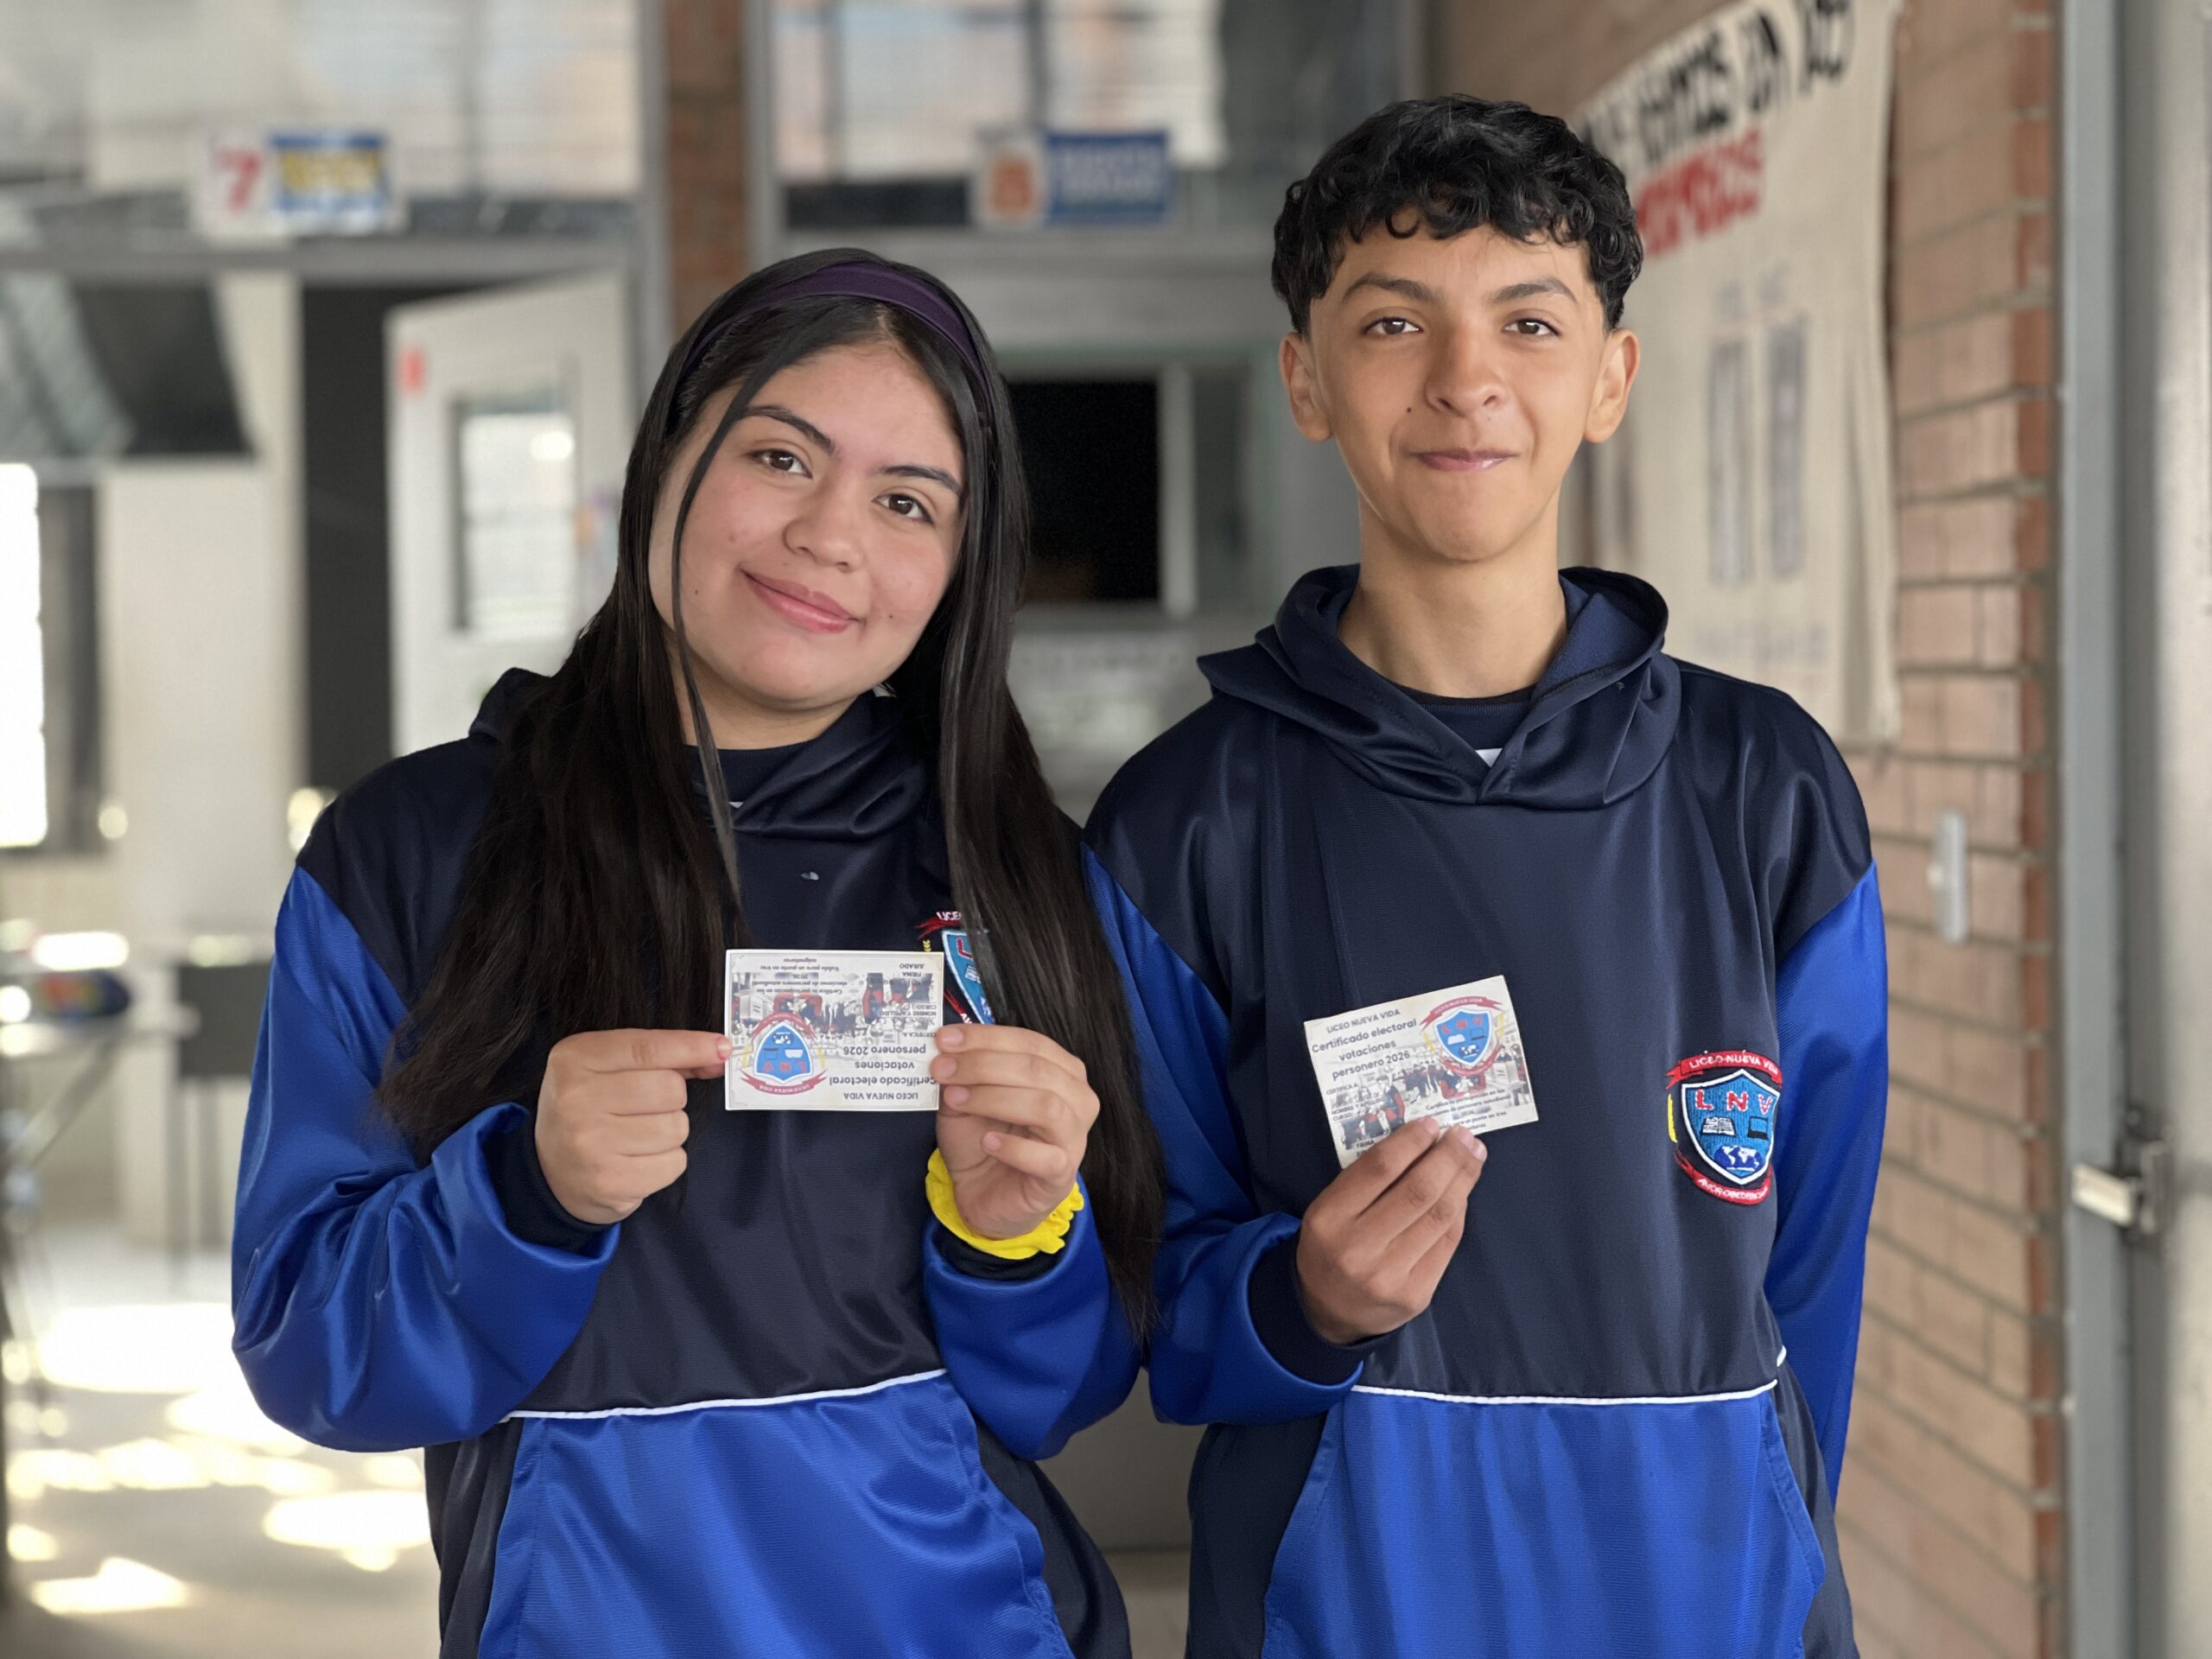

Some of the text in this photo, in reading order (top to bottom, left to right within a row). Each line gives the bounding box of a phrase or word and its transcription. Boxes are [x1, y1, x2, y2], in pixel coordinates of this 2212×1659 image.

[937, 912, 961, 921] LICE
[1326, 1008, 1401, 1033] LICEO NUEVA VIDA
[1312, 1019, 1417, 1053] Certificado electoral
[870, 1045, 926, 1054] personero
[1338, 1040, 1396, 1062] votaciones
[855, 1061, 915, 1071] votaciones
[1332, 1051, 1410, 1081] personero 2026
[1688, 1054, 1724, 1069] LICEO
[830, 1077, 877, 1085] electoral
